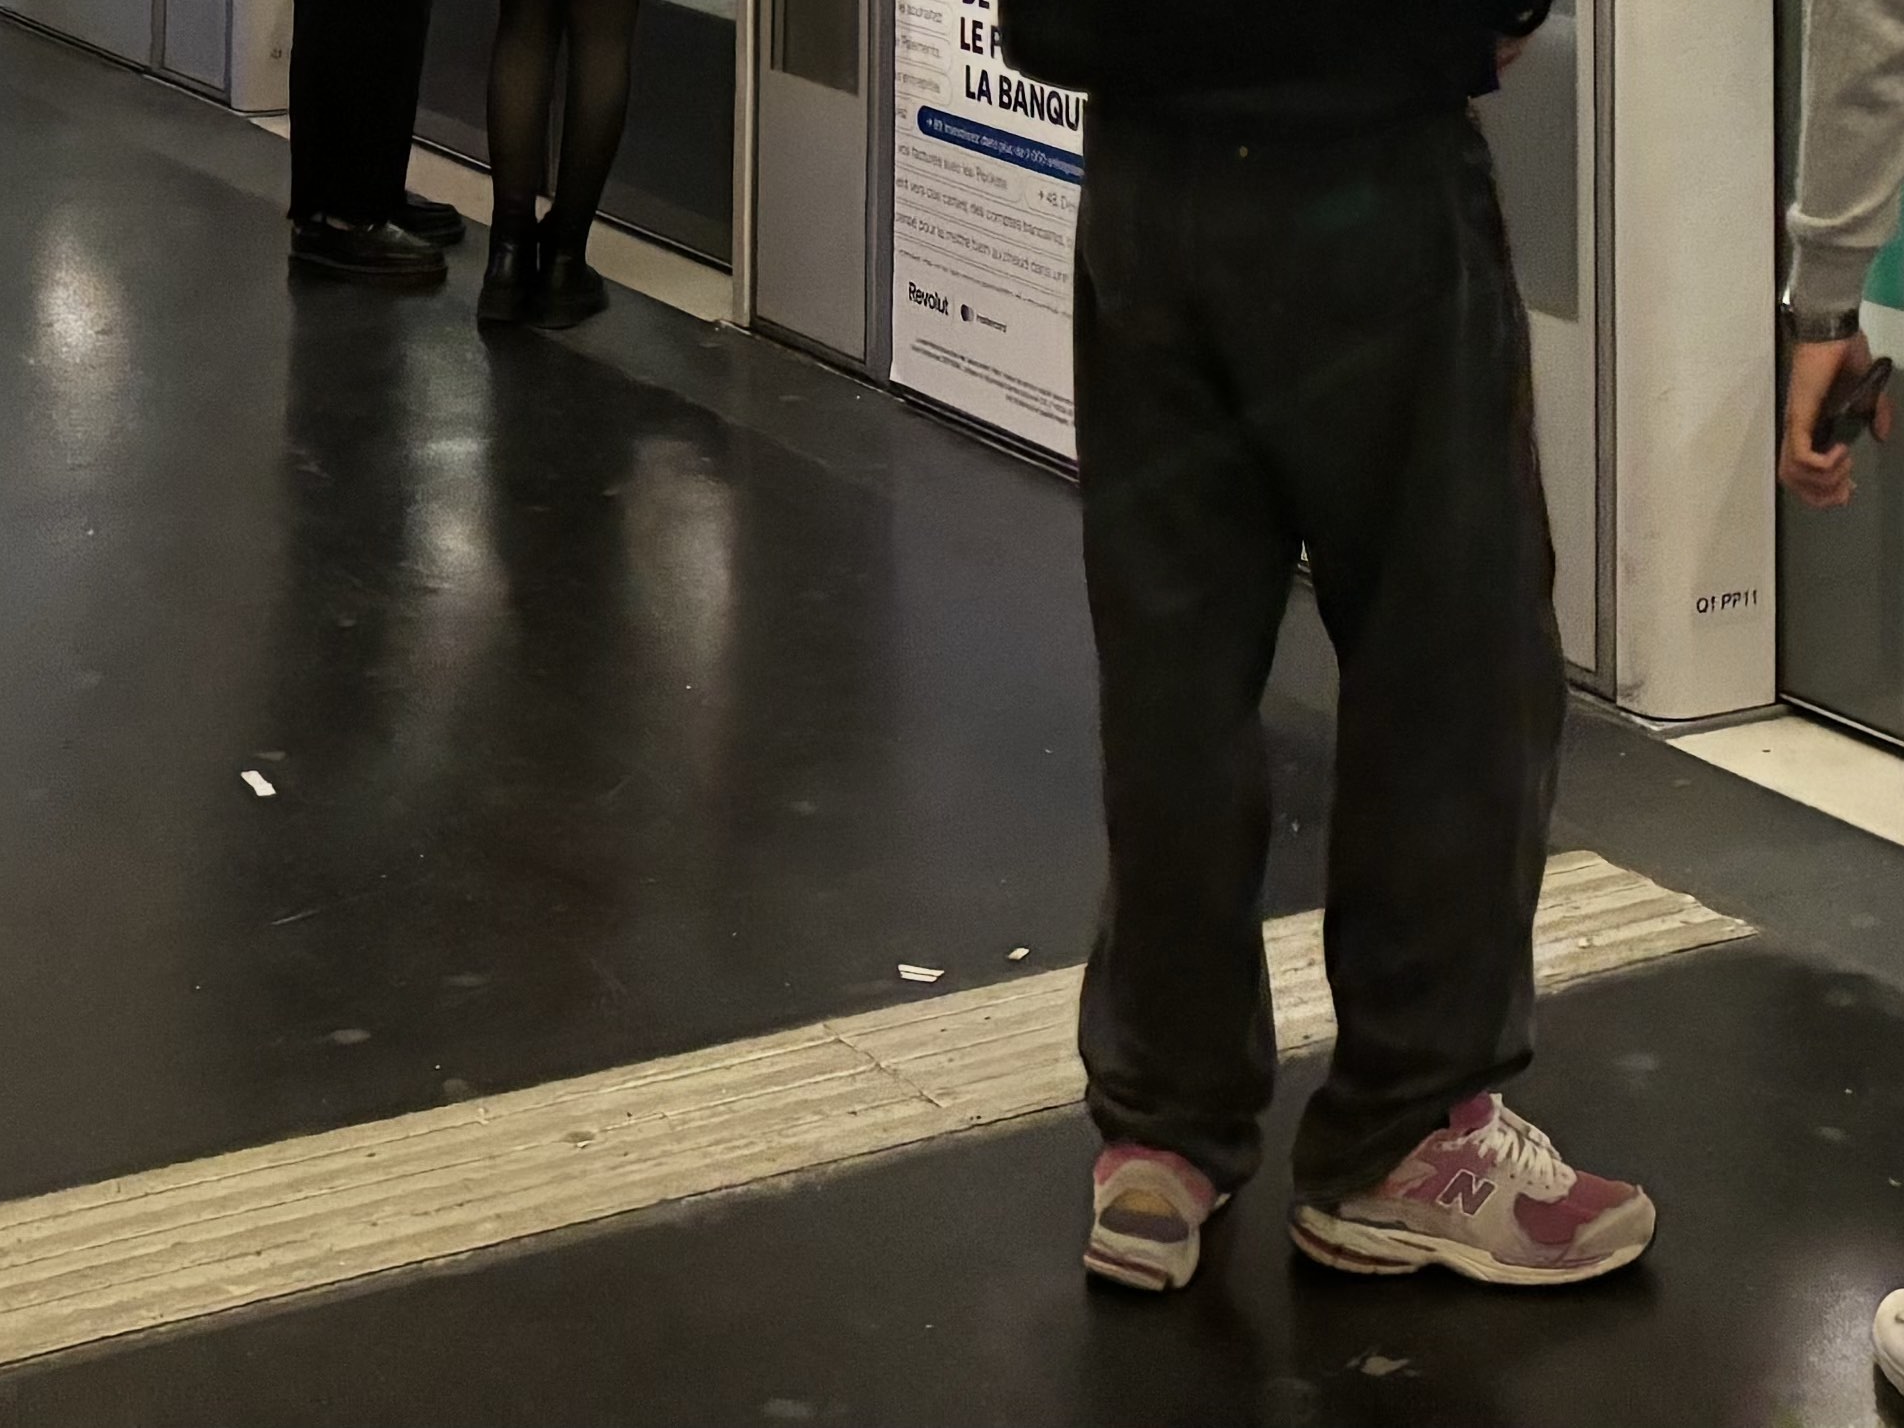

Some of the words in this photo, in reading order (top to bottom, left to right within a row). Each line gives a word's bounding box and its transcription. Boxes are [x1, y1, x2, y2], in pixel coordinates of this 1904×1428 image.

[960, 16, 984, 55] LE
[965, 64, 993, 107] LA
[999, 74, 1080, 132] BANQU
[908, 281, 950, 317] Revolut
[1436, 1169, 1498, 1218] N
